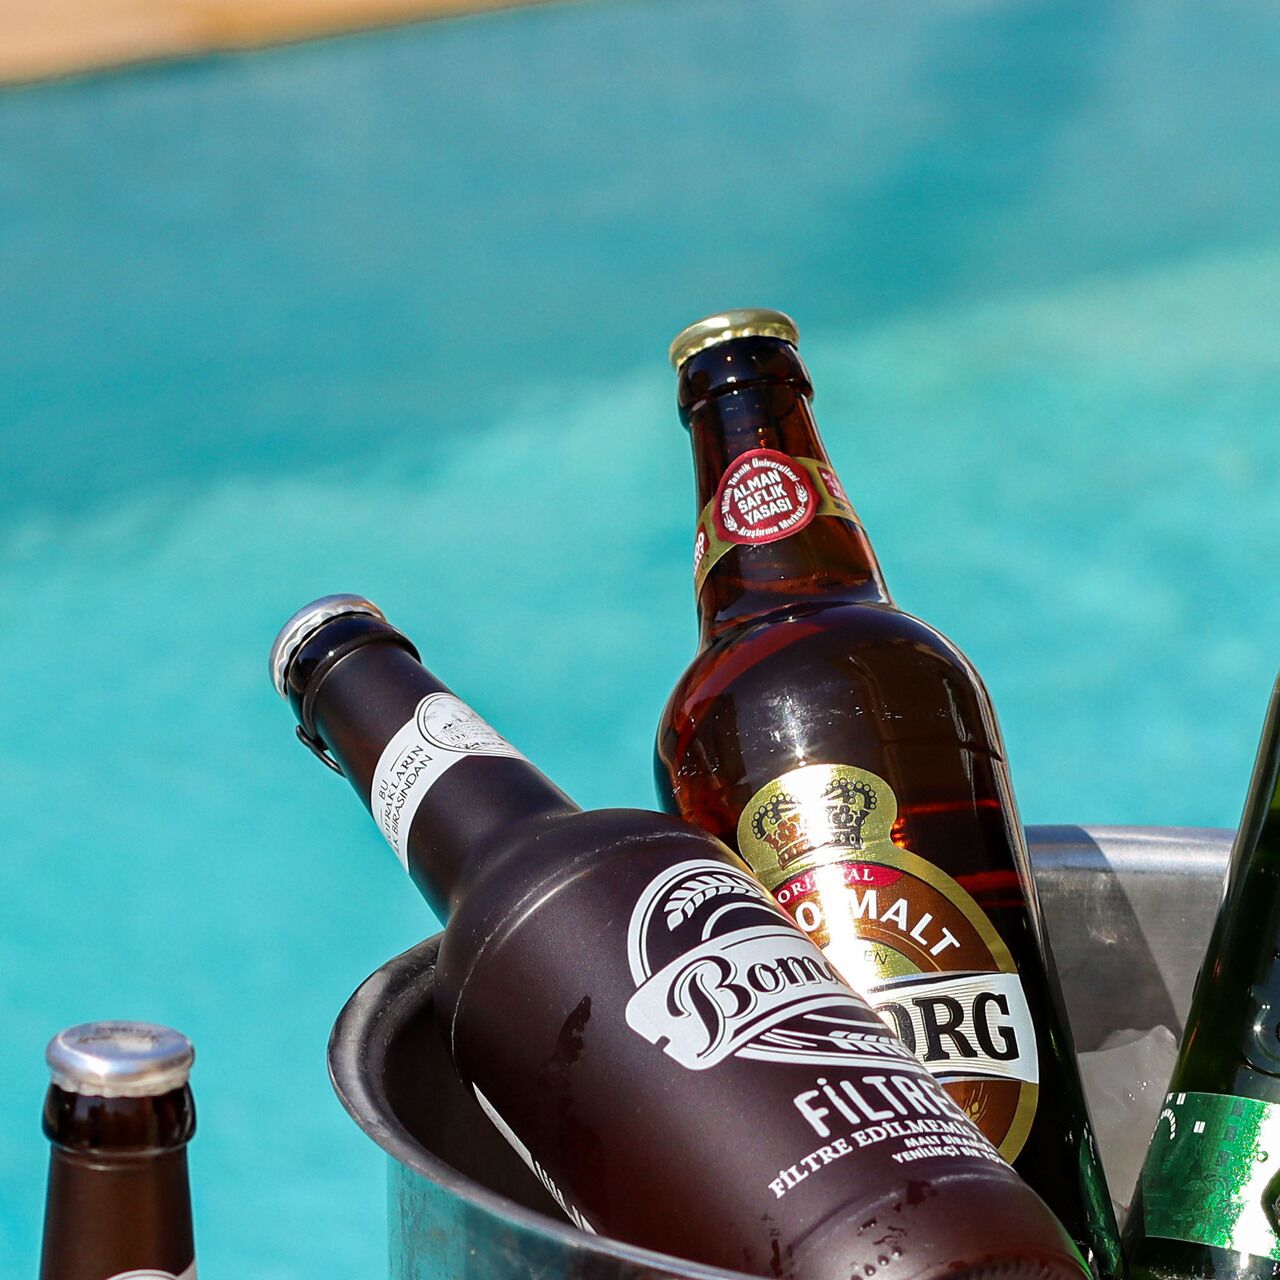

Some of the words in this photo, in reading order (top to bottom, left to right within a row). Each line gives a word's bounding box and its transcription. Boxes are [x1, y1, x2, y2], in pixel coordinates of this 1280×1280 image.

[733, 470, 782, 502] ALMAN
[737, 483, 788, 514] SAFLIK
[743, 497, 794, 526] YASASI
[379, 779, 389, 801] BU
[849, 889, 961, 957] MALT
[891, 1145, 961, 1164] YENİLİKÇİ
[903, 1135, 942, 1148] MALT
[768, 1137, 854, 1199] FİLTRE
